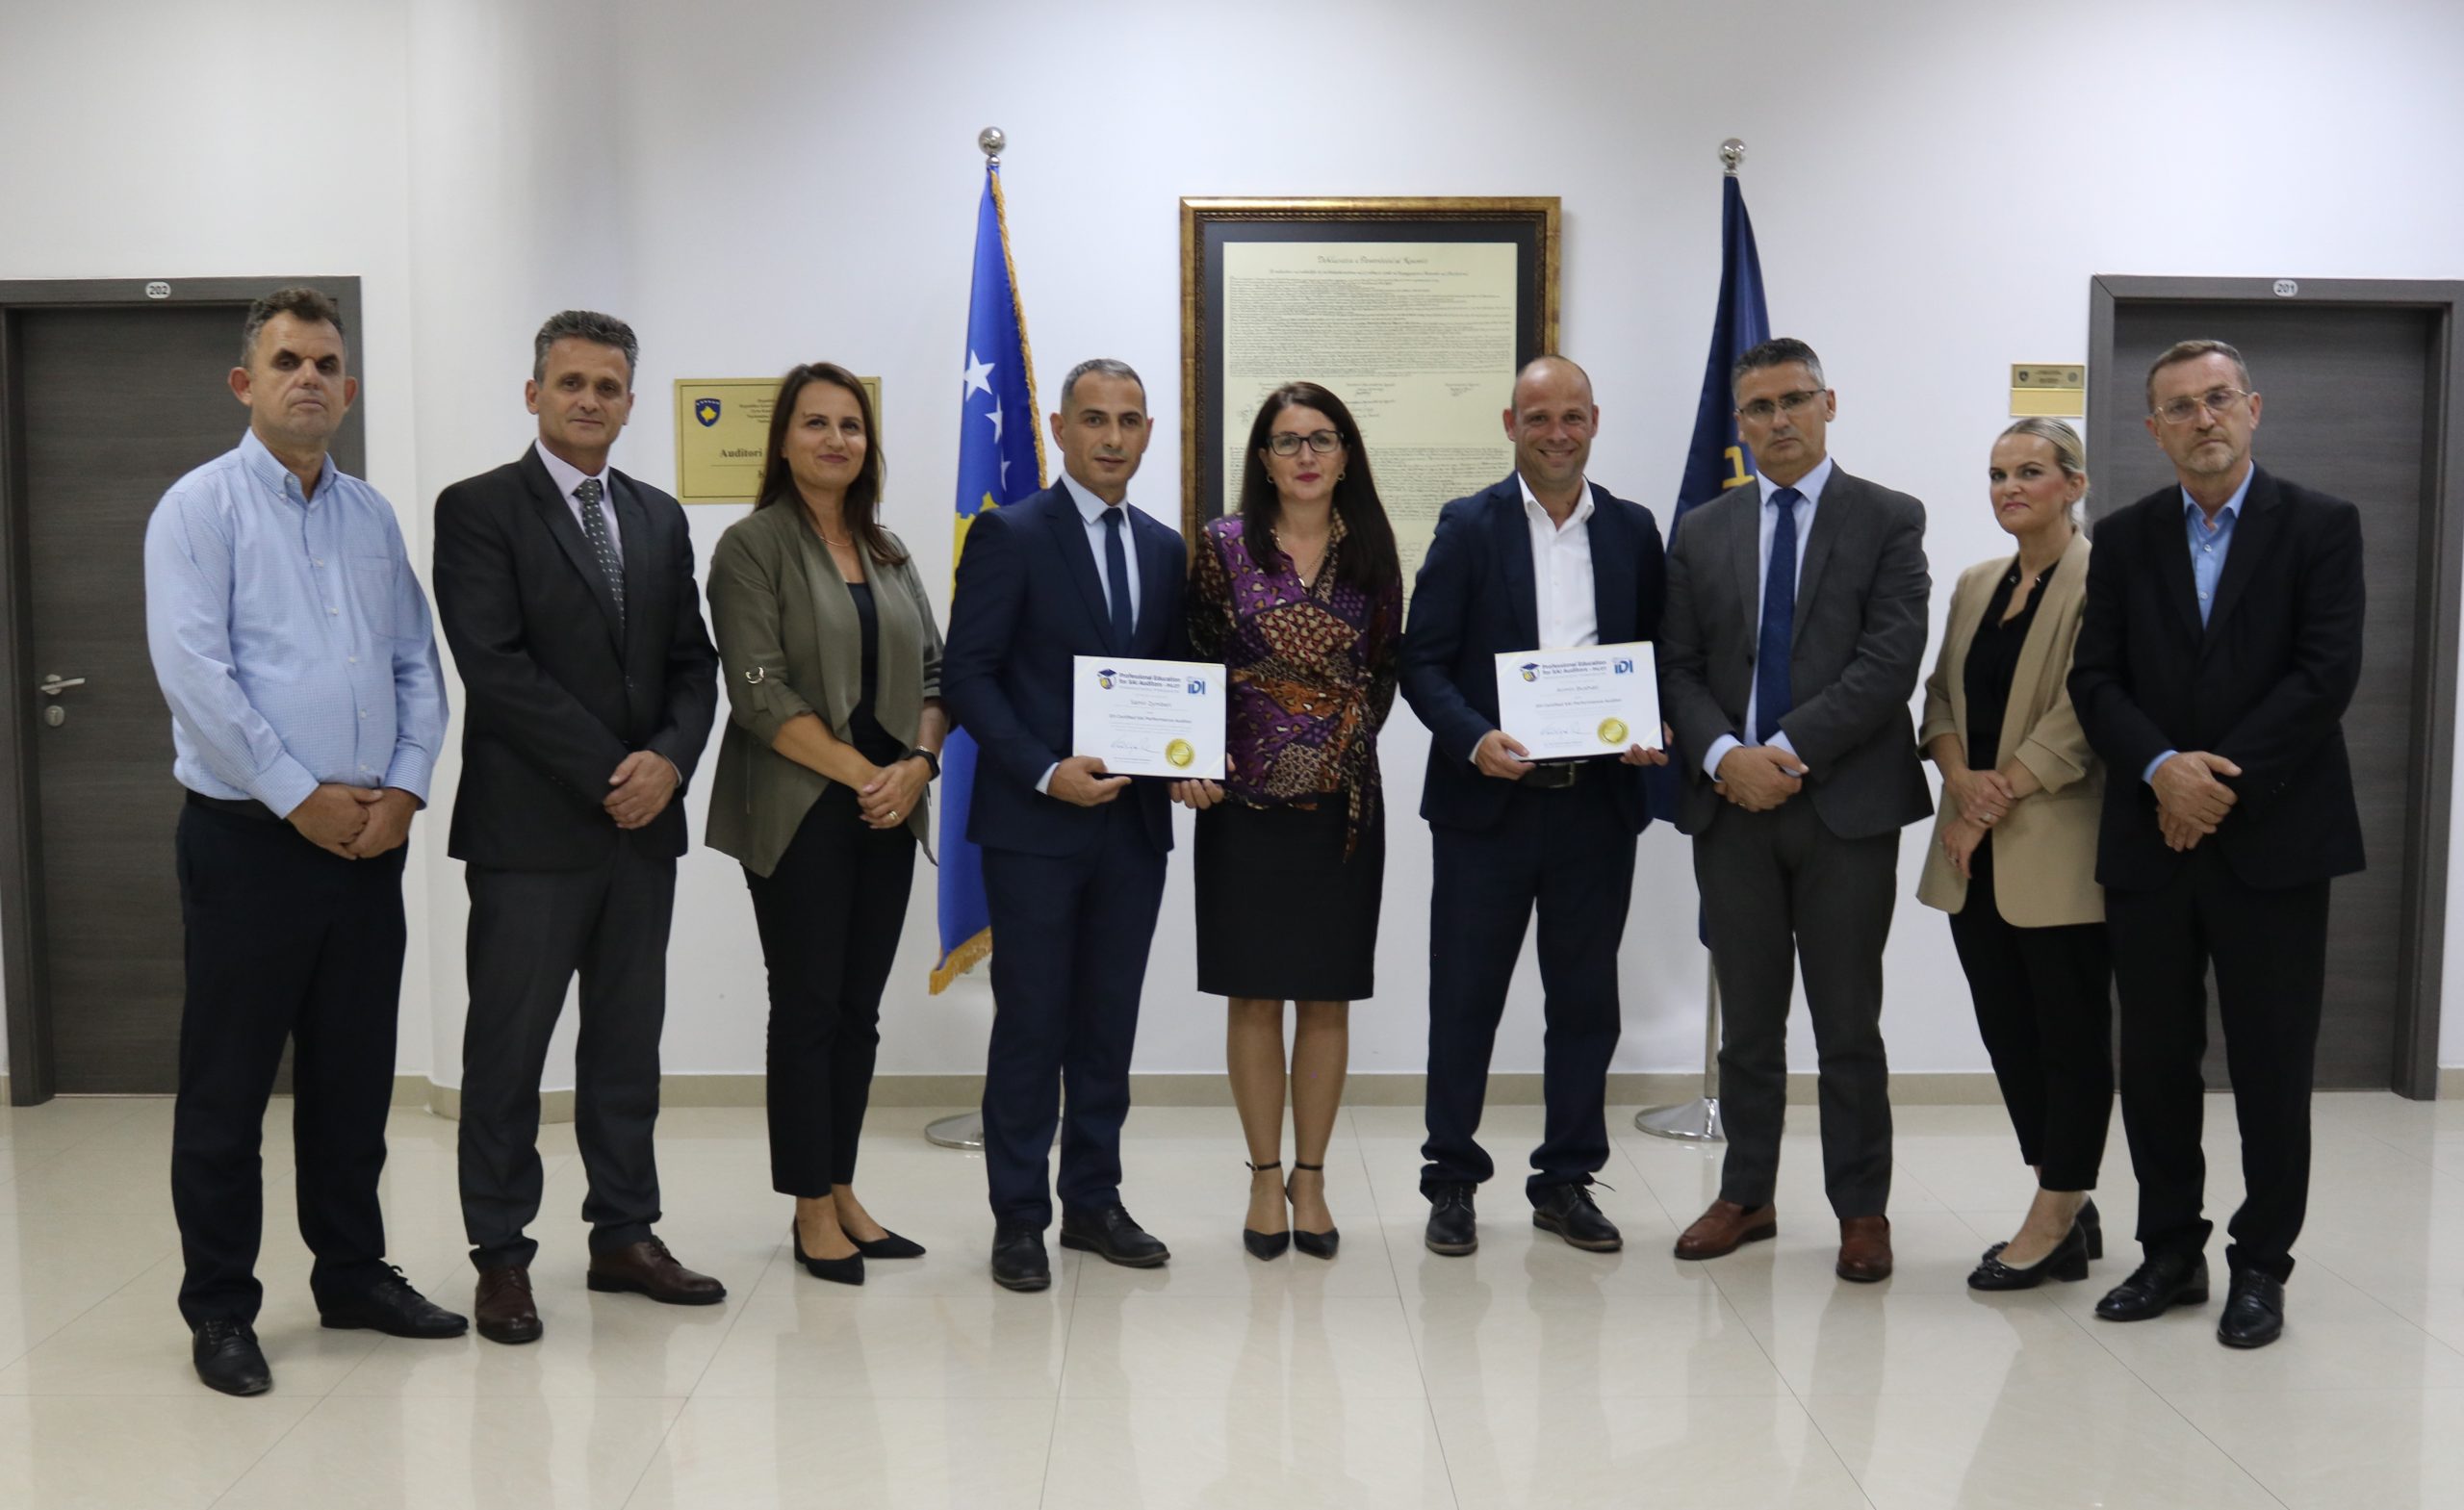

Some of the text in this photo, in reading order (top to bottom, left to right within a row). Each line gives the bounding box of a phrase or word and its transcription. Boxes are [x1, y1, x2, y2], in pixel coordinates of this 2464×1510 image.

[149, 285, 167, 295] 202
[2276, 283, 2295, 294] 201
[720, 448, 762, 458] Auditori
